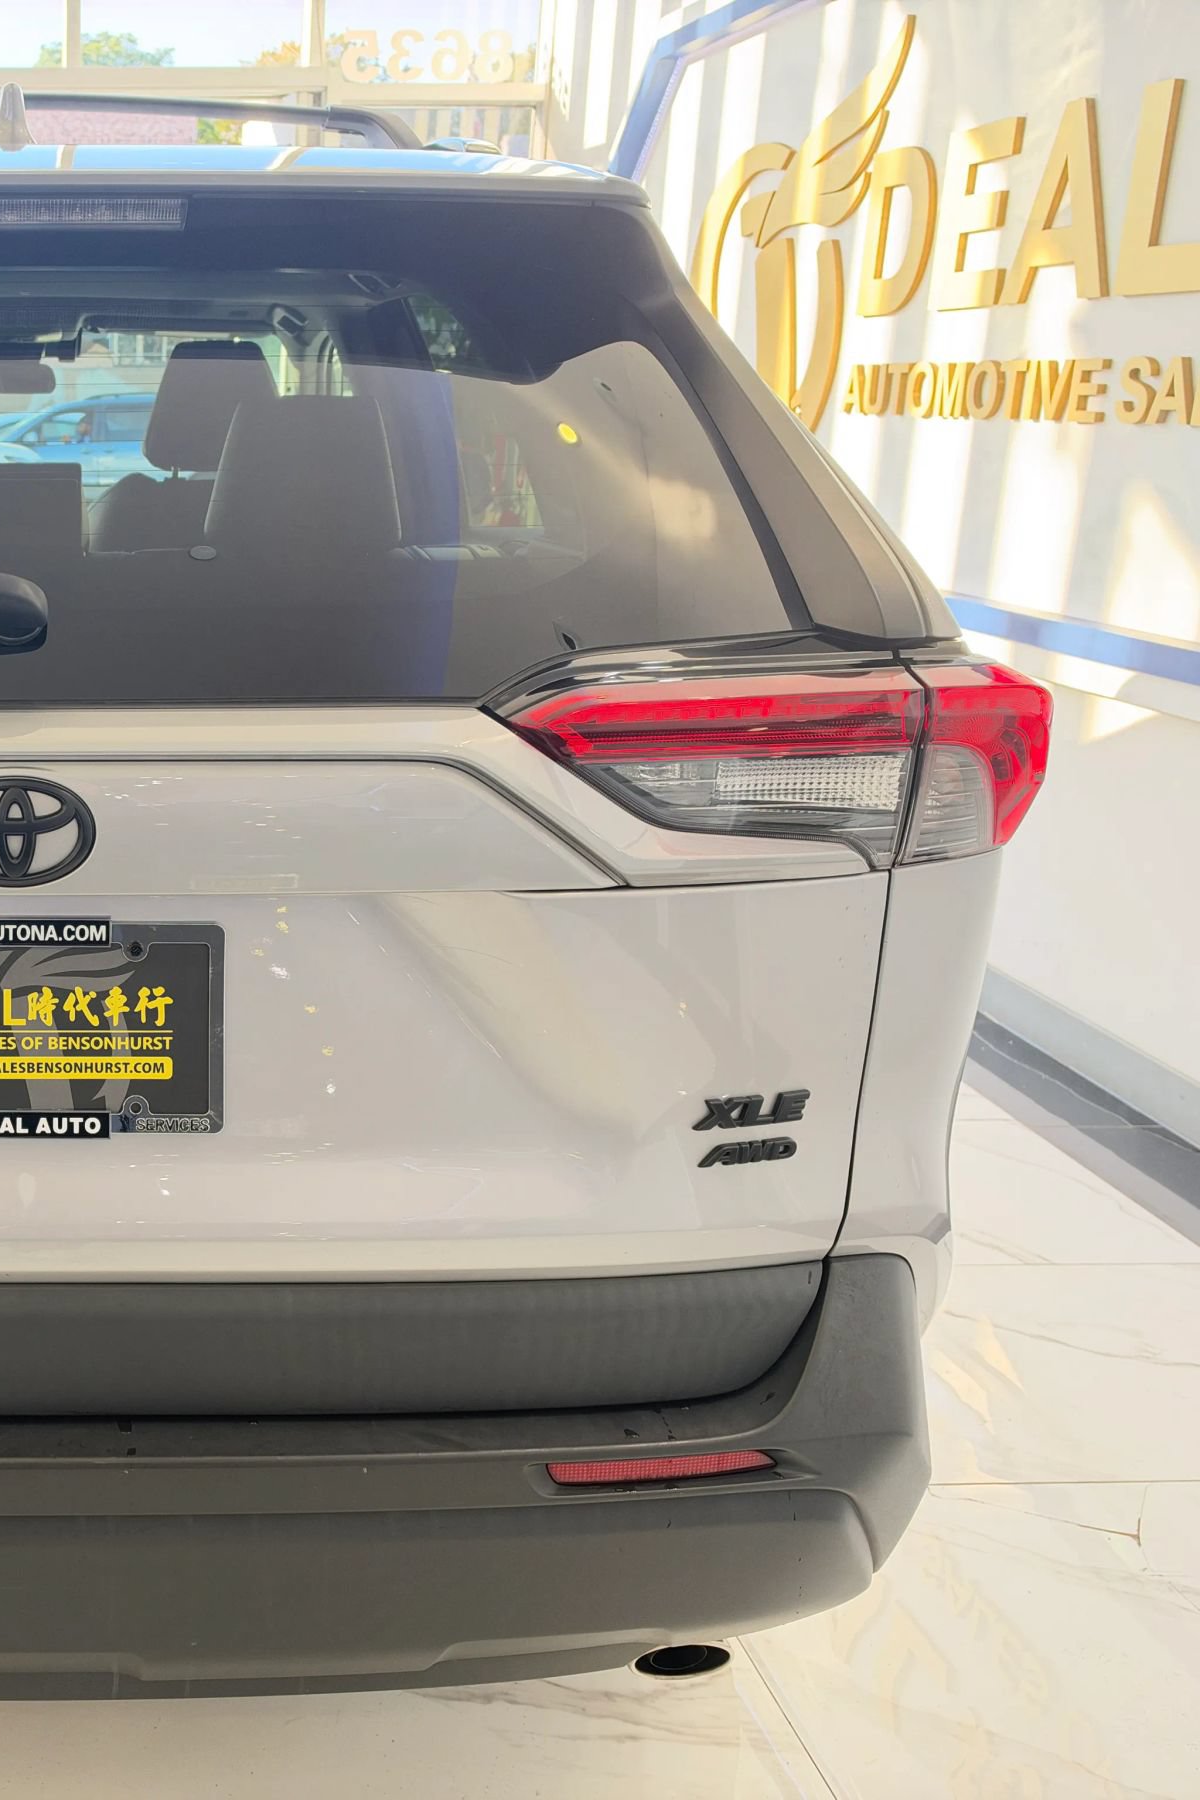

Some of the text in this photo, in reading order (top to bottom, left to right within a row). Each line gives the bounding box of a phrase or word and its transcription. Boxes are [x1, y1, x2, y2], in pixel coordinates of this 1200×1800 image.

[842, 357, 1113, 424] AUTOMOTIVE
[21, 1036, 43, 1050] OF
[48, 1036, 173, 1050] BENSONHURST
[691, 1088, 811, 1131] XLE
[35, 1117, 101, 1134] AUTO
[136, 1117, 210, 1132] SERVICES
[697, 1136, 798, 1168] AWD
